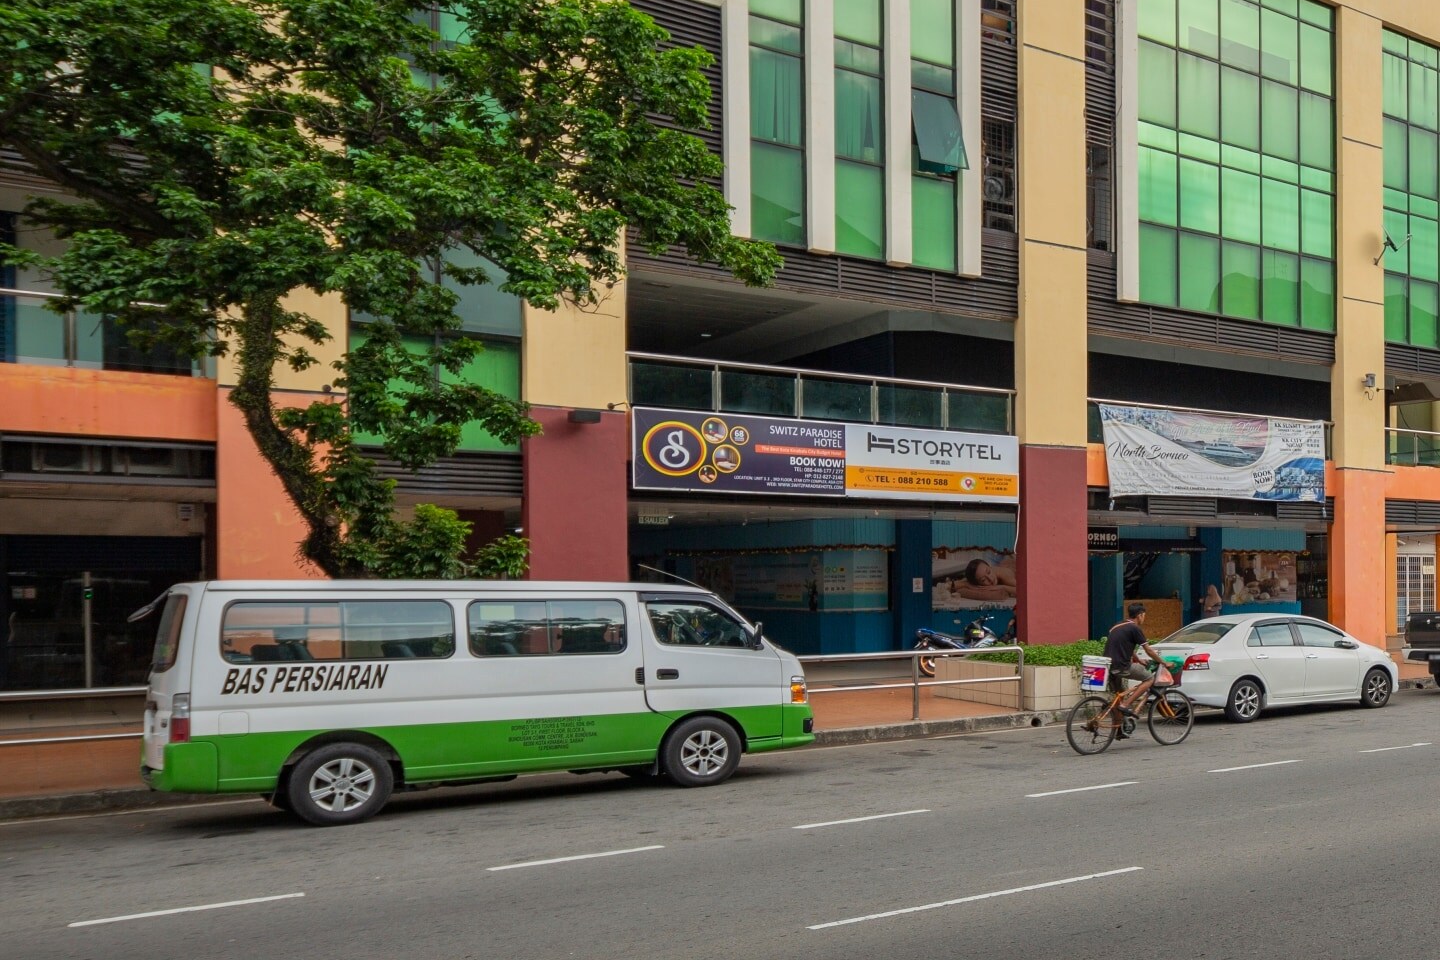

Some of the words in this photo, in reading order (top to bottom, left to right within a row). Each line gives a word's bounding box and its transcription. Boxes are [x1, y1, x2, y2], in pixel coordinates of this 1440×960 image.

[734, 429, 745, 437] 68
[769, 425, 798, 436] SWITZ
[800, 427, 842, 439] PARADISE
[814, 438, 842, 448] HOTEL
[897, 438, 1001, 460] STORYTEL
[1108, 441, 1146, 458] North
[1146, 444, 1189, 460] Borneo
[790, 456, 816, 467] BOOK
[818, 458, 845, 468] NOW!
[1253, 470, 1272, 478] BOOK
[875, 475, 890, 483] TEL
[898, 476, 913, 485] 088
[916, 477, 931, 485] 210
[933, 477, 948, 486] 588
[1254, 476, 1273, 485] NOW!
[220, 667, 268, 695] BAS
[269, 664, 389, 693] PERSIARAN
